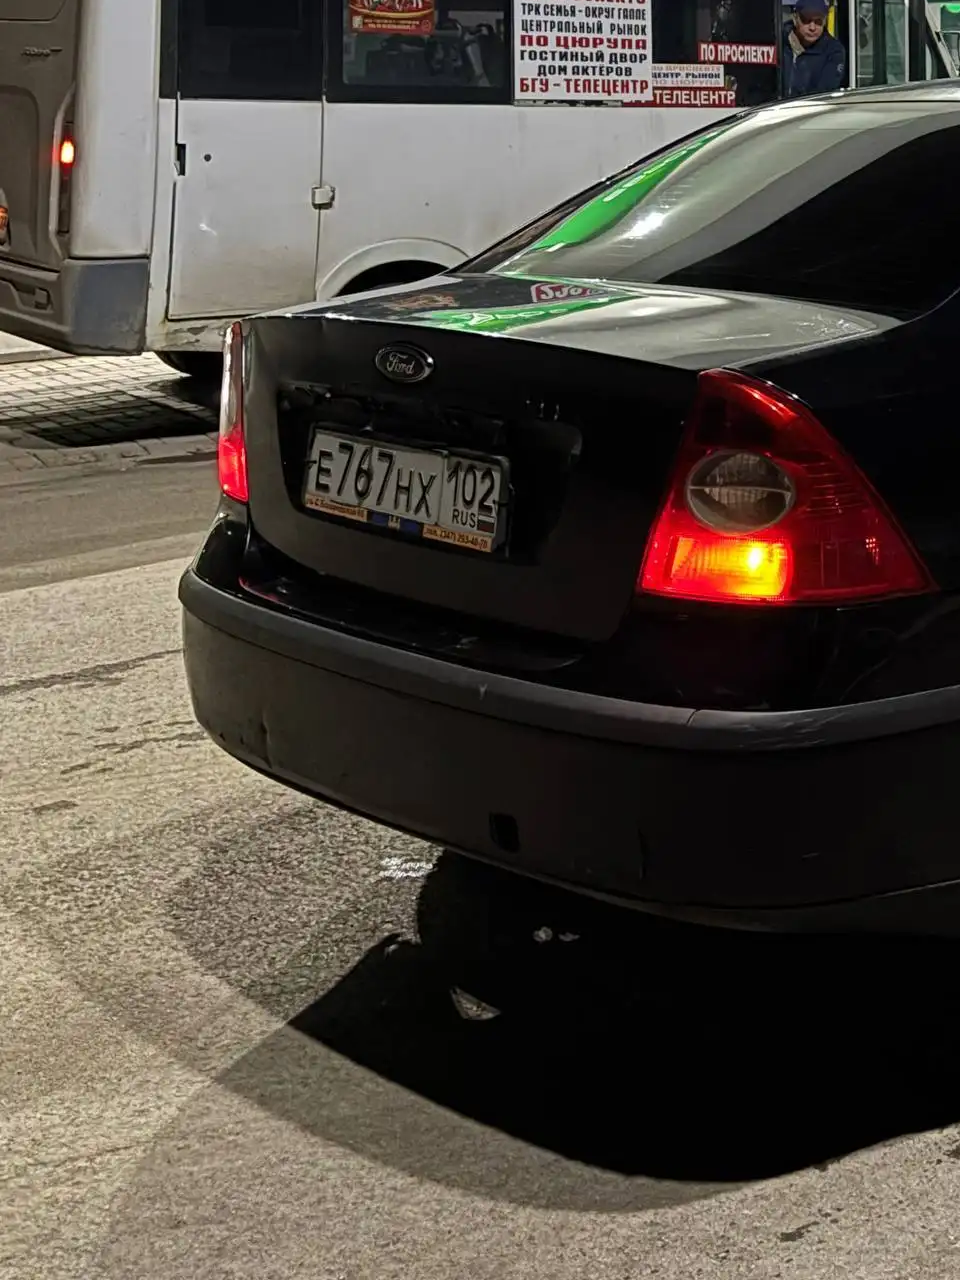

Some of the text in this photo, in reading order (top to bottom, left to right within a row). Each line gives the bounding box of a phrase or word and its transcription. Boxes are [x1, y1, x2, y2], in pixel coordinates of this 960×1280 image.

[521, 3, 541, 16] ТРК
[543, 4, 576, 18] СЕМЬЯ
[585, 6, 616, 19] ОКРУГ
[610, 23, 647, 36] РЫНОК
[520, 34, 647, 50] ПО ЦЮРУПА
[520, 49, 648, 65] ГОСТИНЫЙ ДВОР
[701, 44, 775, 63] ПО ПРОСПЕКТУ
[537, 64, 568, 77] ДОМ
[685, 72, 721, 80] РЫНОК
[519, 77, 549, 93] БГУ
[654, 90, 736, 106] ТЕЛЕЦЕНТР
[387, 354, 415, 375] Ford
[447, 460, 495, 514] 102
[451, 509, 476, 528] RUS
